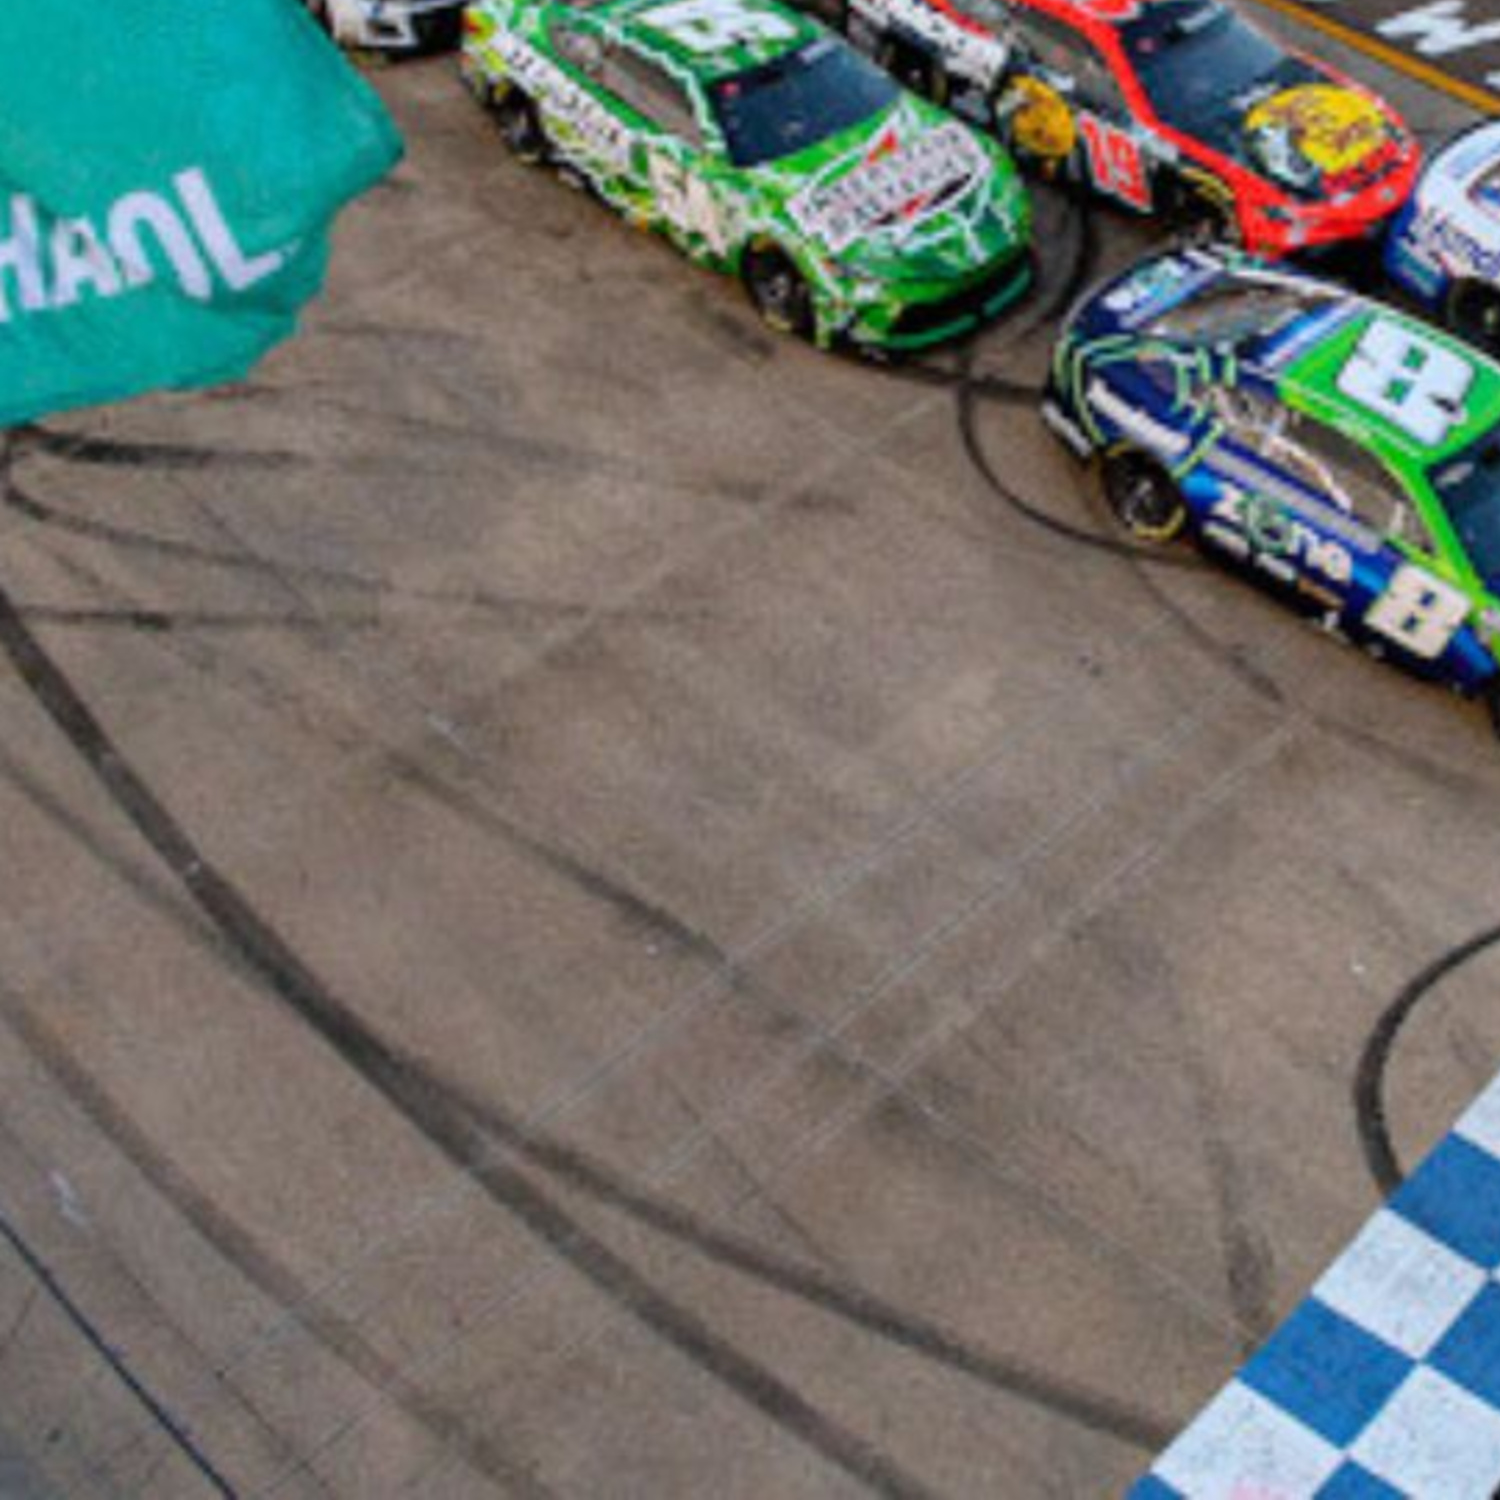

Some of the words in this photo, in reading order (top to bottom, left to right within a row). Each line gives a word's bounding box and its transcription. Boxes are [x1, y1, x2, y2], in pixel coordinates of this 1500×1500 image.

[1079, 108, 1152, 214] 19
[1336, 315, 1473, 447] 8
[1362, 561, 1470, 661] 8
